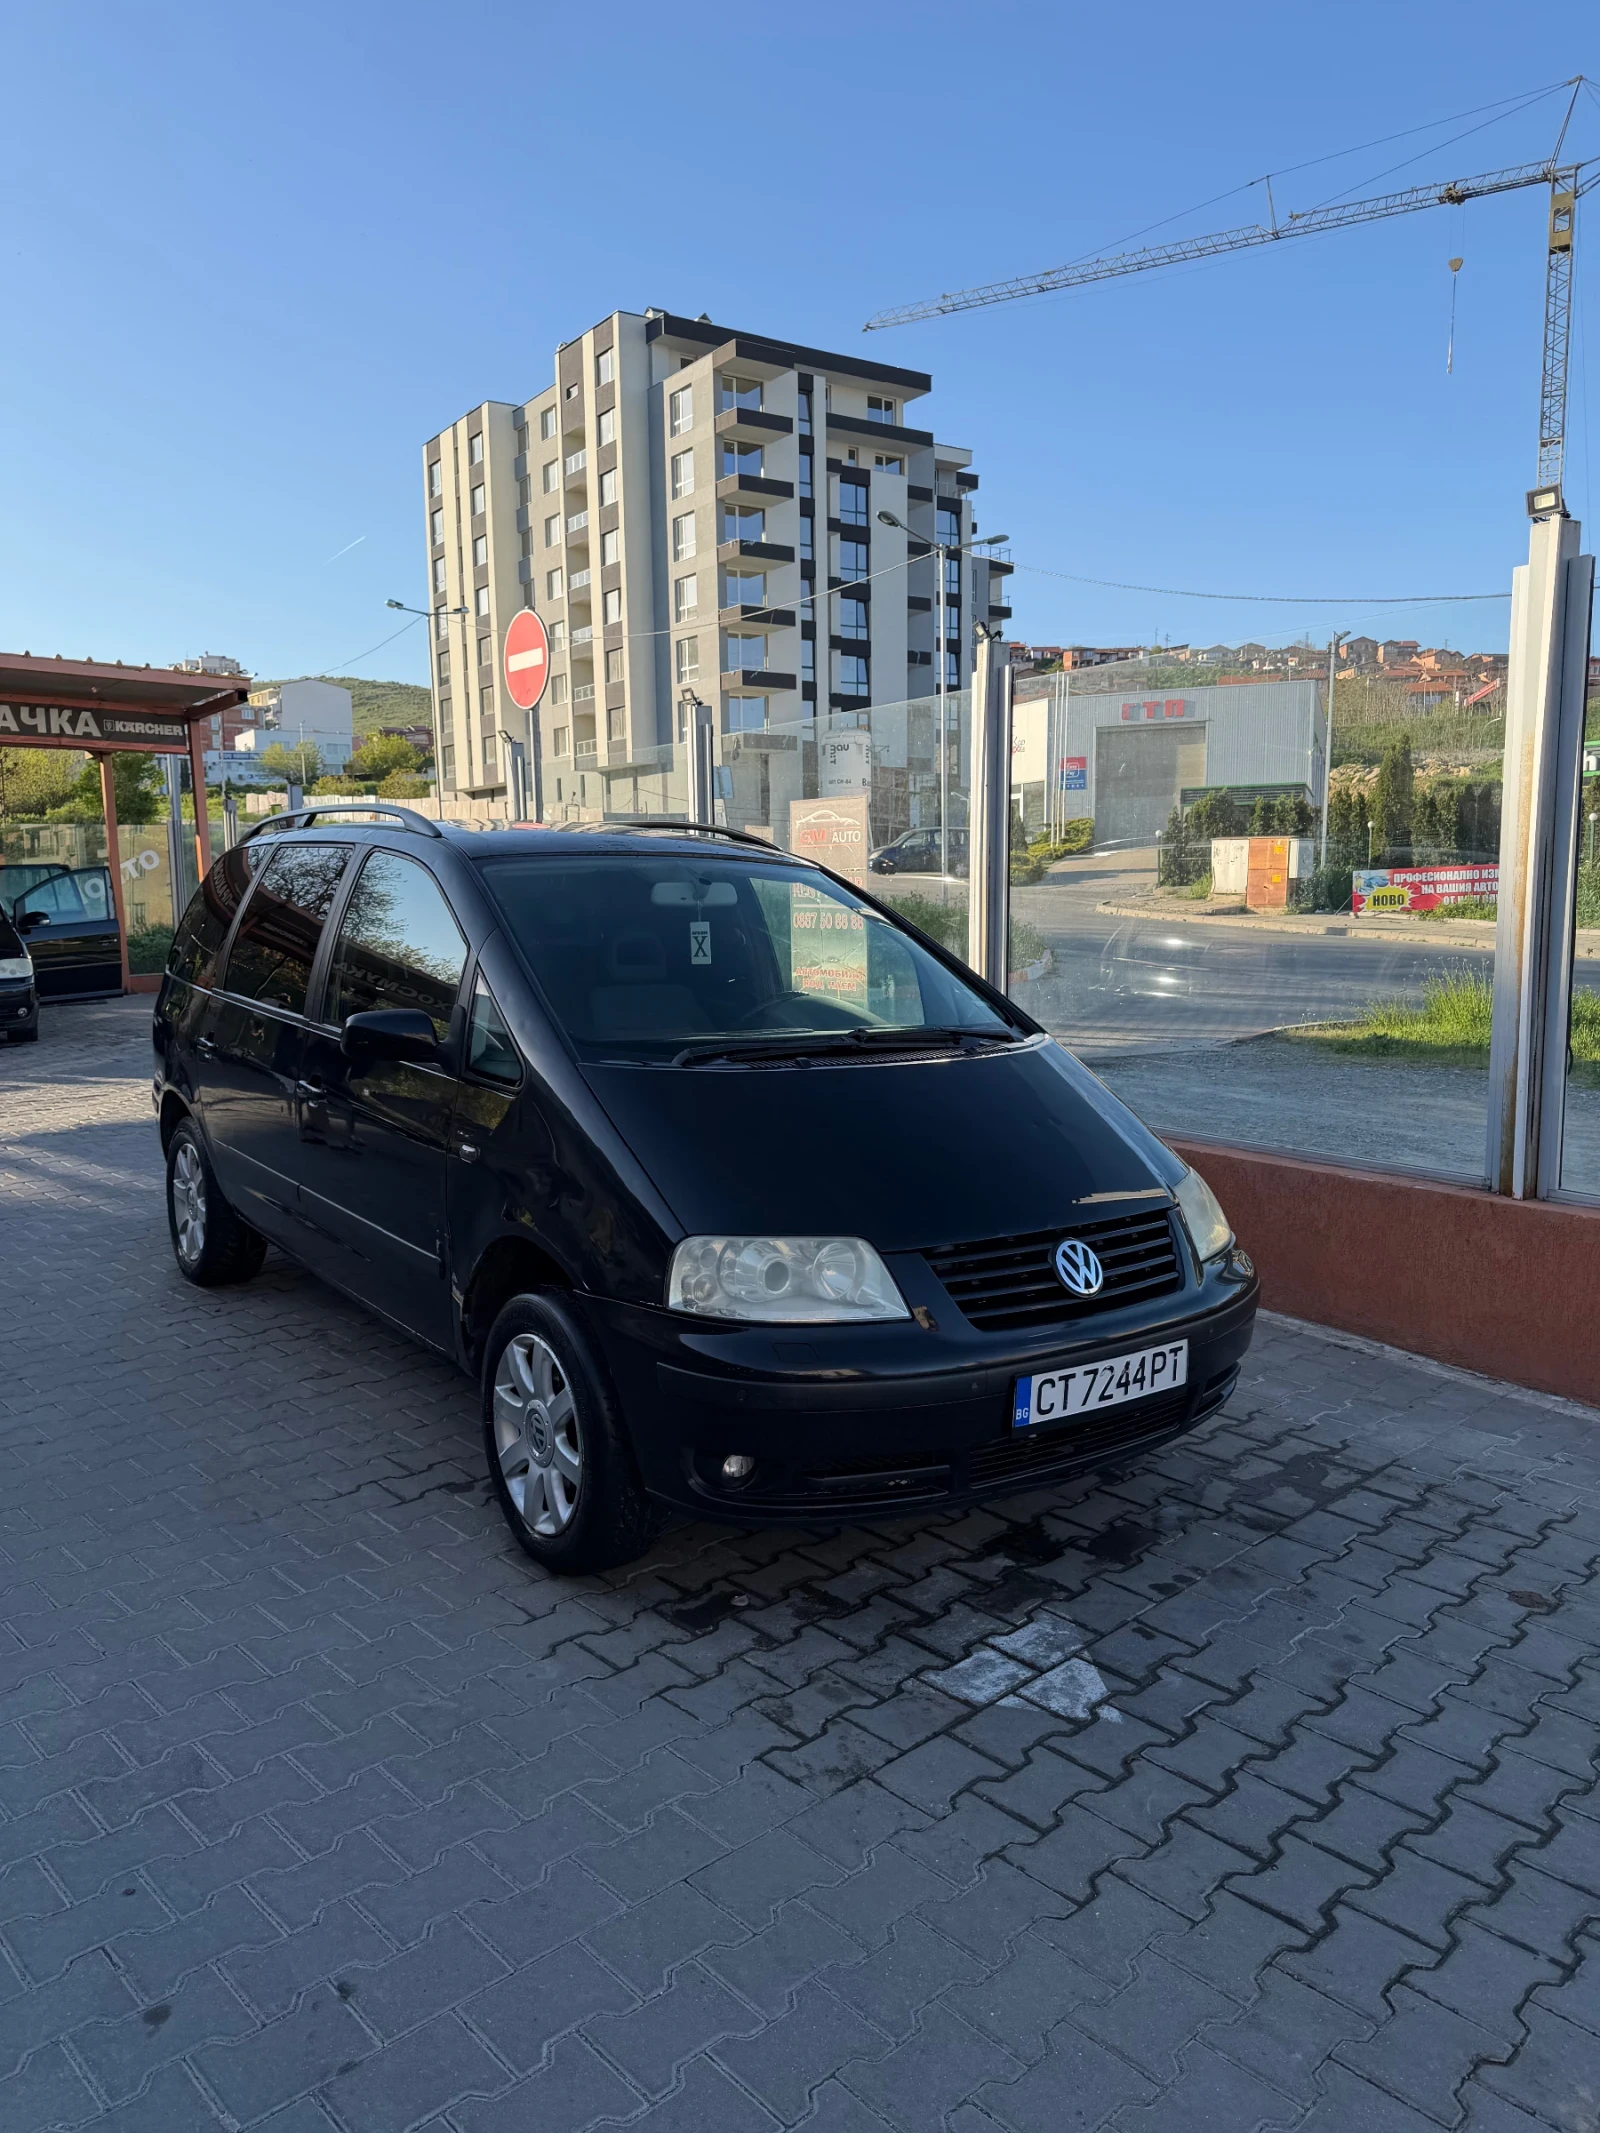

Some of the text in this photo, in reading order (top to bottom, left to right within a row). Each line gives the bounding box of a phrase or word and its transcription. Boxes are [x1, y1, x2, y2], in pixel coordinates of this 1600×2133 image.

[1122, 699, 1184, 720] ГТП
[115, 720, 183, 736] KÄRCHER
[800, 829, 861, 843] GM AUTO
[1393, 870, 1479, 883] ПРОФЕСИОНАЛНО
[1421, 884, 1434, 894] НА
[1437, 883, 1472, 893] ВАШИЯ
[1373, 894, 1404, 906] НОВО
[692, 936, 708, 957] X
[1015, 1408, 1029, 1420] BG
